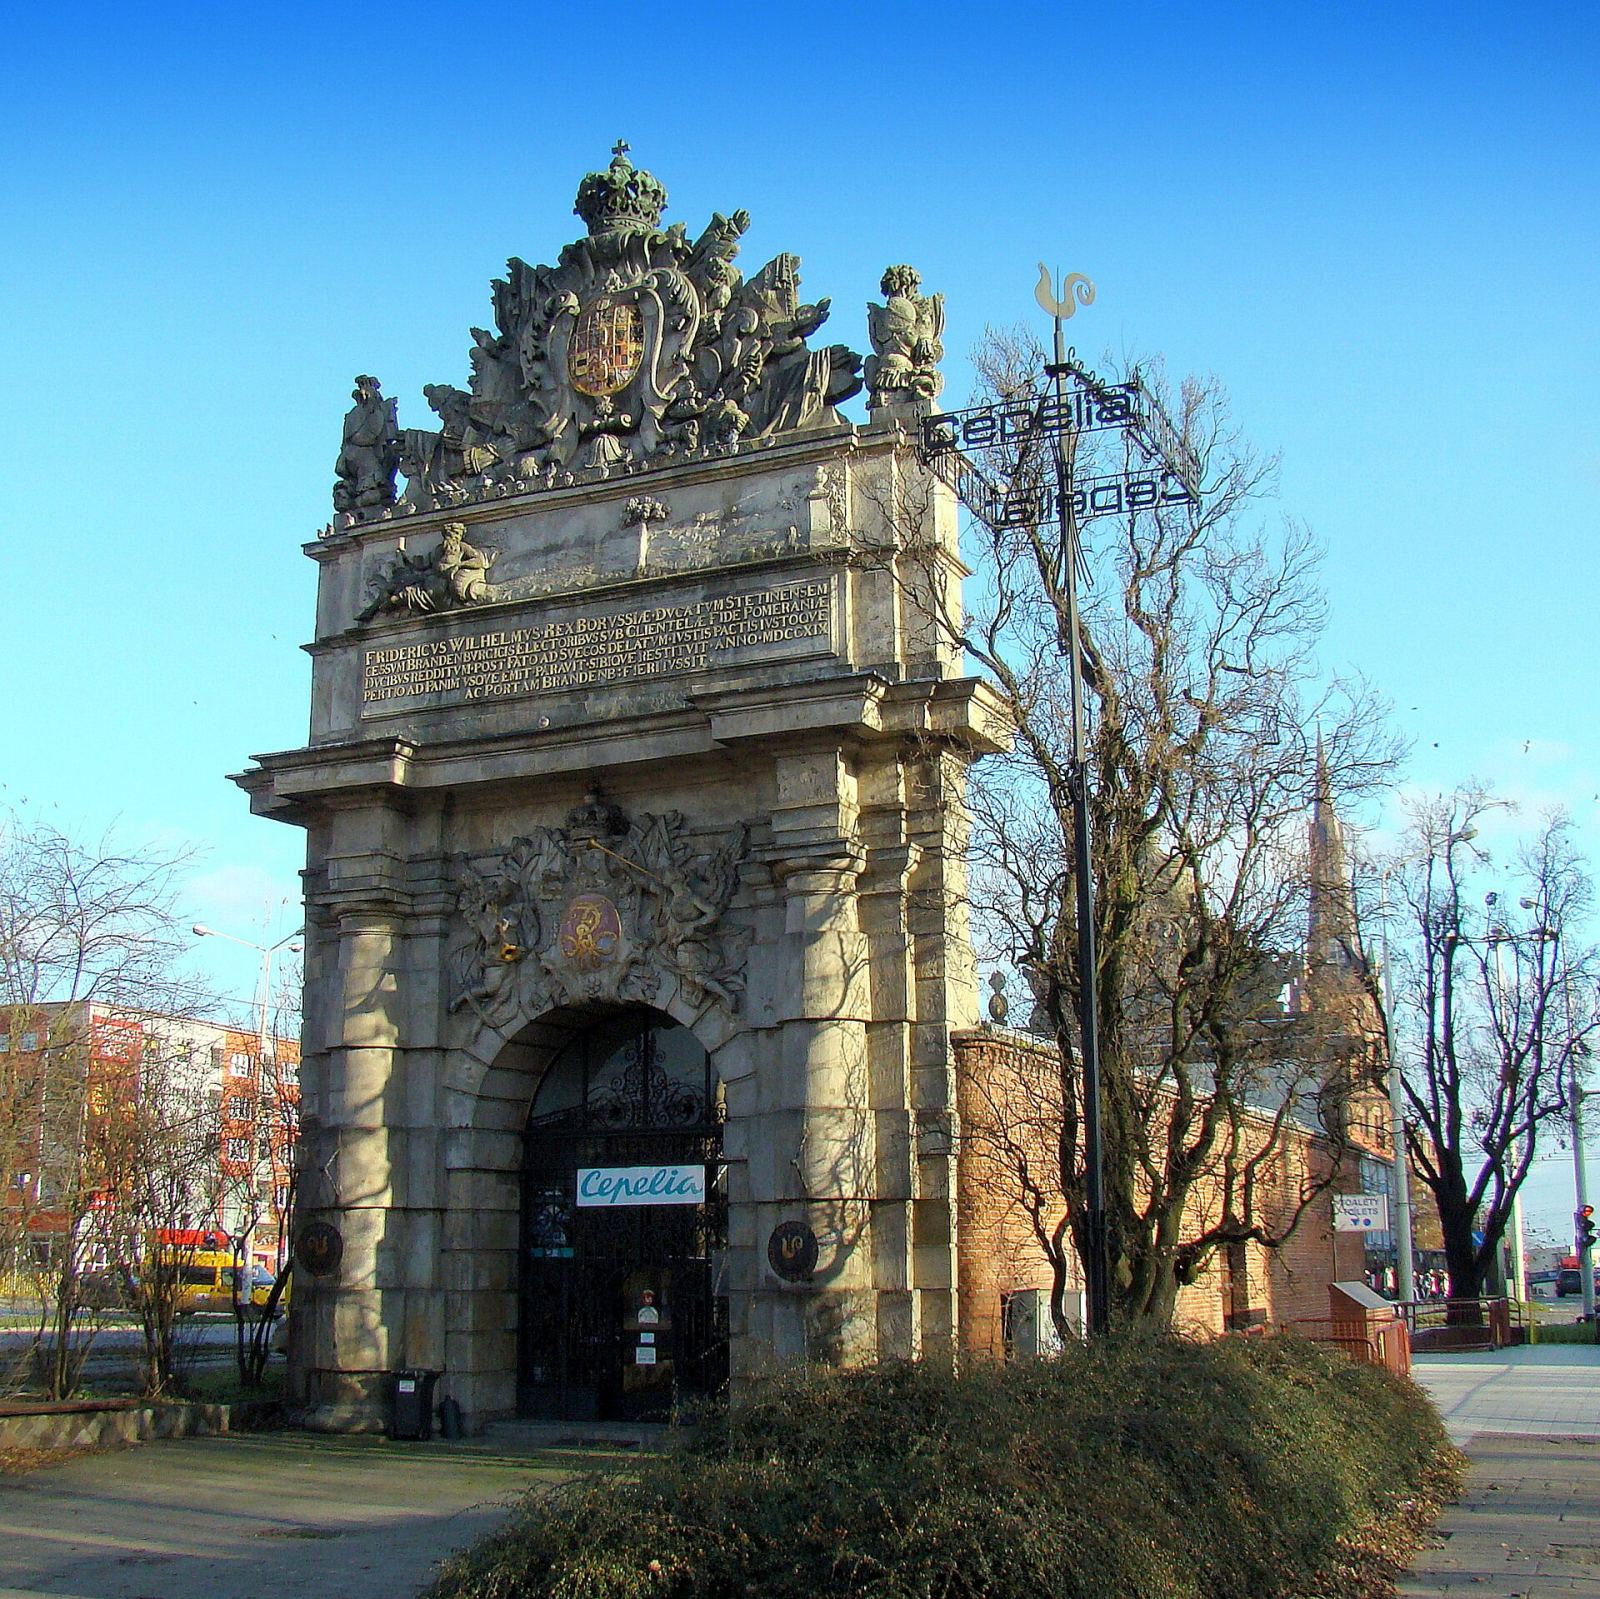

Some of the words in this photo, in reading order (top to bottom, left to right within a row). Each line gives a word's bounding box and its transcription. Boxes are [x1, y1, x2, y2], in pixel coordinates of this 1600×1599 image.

[924, 393, 1131, 449] Cepelia
[364, 673, 410, 690] DVCIBVS
[474, 659, 506, 673] POST
[507, 654, 538, 669] FATO
[540, 651, 558, 664] AD
[560, 644, 606, 661] SVECOS
[672, 627, 712, 644] IVSTIS
[713, 620, 758, 638] PACTIS
[365, 641, 447, 666] FRIDERICVS
[544, 622, 574, 638] REX
[655, 599, 724, 622] DVCATVM
[726, 583, 828, 610] STETINENSEM
[365, 661, 406, 677] CESSVM
[516, 632, 599, 655] ELECTORIBVS
[599, 628, 624, 642] SVB
[625, 616, 707, 638] CLIENTELÆ
[709, 609, 741, 625] FIDE
[743, 596, 829, 620] POMERANIÆ
[406, 683, 425, 696] AD
[502, 667, 532, 682] EMIT
[763, 623, 829, 643] MDCCXIX
[465, 687, 482, 700] AC
[484, 678, 540, 697] PORTAM
[623, 660, 659, 677] FIERI
[580, 1168, 703, 1204] Cepelia
